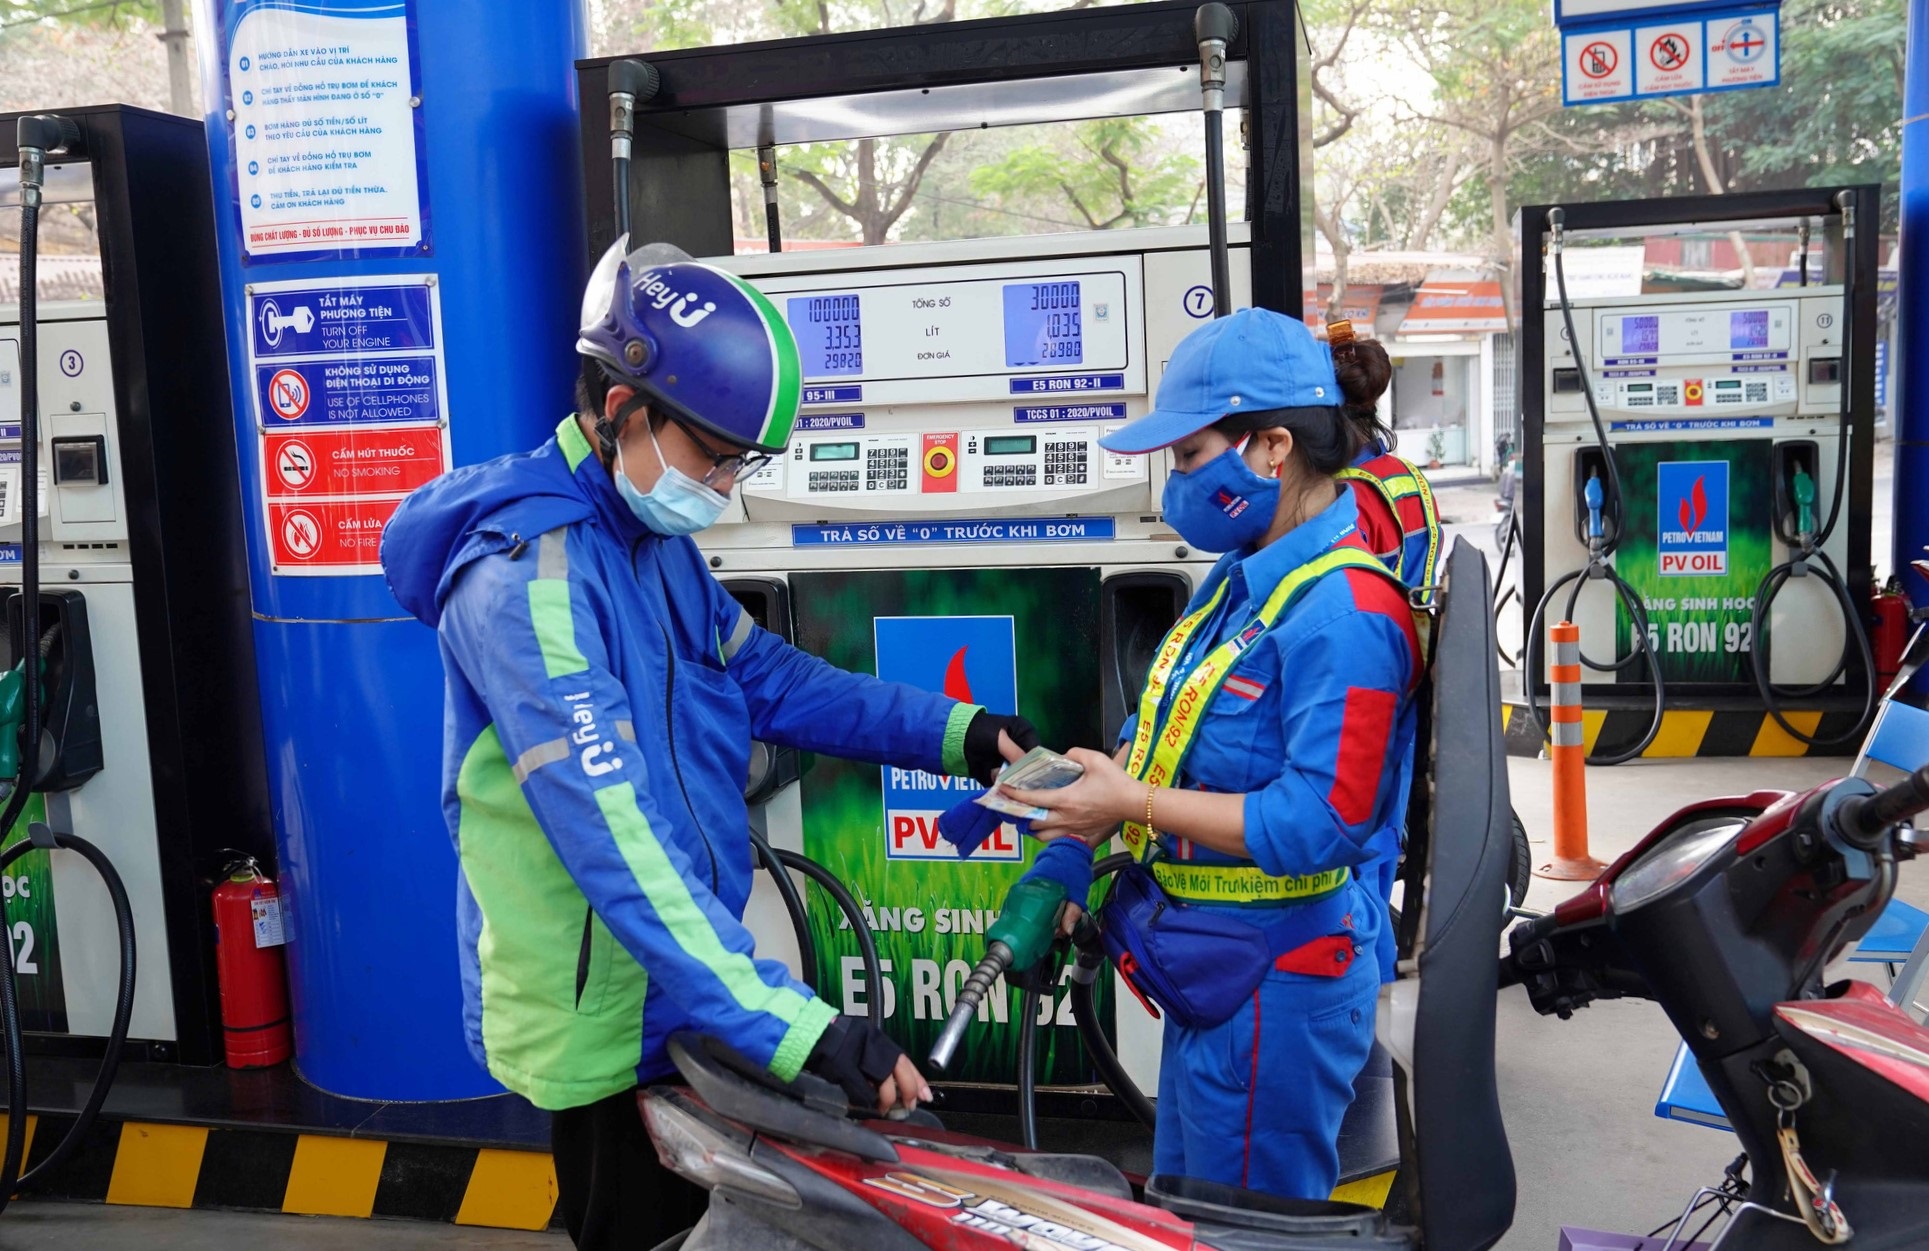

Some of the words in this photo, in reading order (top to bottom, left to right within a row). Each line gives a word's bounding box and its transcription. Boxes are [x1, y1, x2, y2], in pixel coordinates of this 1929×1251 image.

[350, 226, 367, 236] PHỤC
[380, 226, 393, 234] CHU
[320, 296, 337, 306] TẮT
[340, 295, 363, 305] MÁY
[912, 298, 935, 308] TỔNG
[939, 297, 951, 307] SỐ
[1031, 284, 1079, 310] 30000
[1195, 293, 1205, 309] 7
[321, 307, 366, 318] PHƯƠNG
[369, 306, 391, 318] TIỆN
[809, 297, 859, 322] 100000
[322, 326, 346, 336] TURN
[349, 326, 367, 334] OFF
[926, 325, 939, 336] LÍT
[323, 339, 350, 349] YOUR
[352, 337, 390, 347] ENGINE
[825, 352, 861, 369] 29820
[918, 352, 934, 360] ĐƠN
[936, 350, 950, 359] GIÁ
[68, 356, 75, 370] 3
[326, 366, 361, 376] KHÔNG
[364, 365, 377, 375] SỬ
[380, 364, 410, 375] DỤNG
[326, 378, 348, 388] ĐIỆN
[351, 376, 382, 387] THOẠI
[385, 376, 395, 385] DI
[398, 375, 429, 386] ĐỘNG
[1033, 380, 1046, 391] E5
[1049, 379, 1071, 390] RON
[1075, 378, 1100, 389] 92-II
[328, 397, 344, 406] USE
[347, 396, 360, 405] OF
[363, 394, 429, 405] CELLPHONES
[807, 390, 835, 400] 95-III
[329, 410, 337, 419] IS
[339, 409, 359, 419] NOT
[362, 407, 411, 418] ALLOWED
[1026, 410, 1047, 419] TCCS
[1050, 409, 1060, 418] 01
[1067, 407, 1113, 418] 2020/PVOIL
[810, 417, 853, 427] 2020/PVOIL
[1645, 422, 1655, 430] SỐ
[333, 447, 355, 459] CẤM
[358, 447, 378, 458] HÚT
[379, 446, 415, 457] THUỐC
[334, 468, 349, 477] NO
[352, 466, 400, 476] SMOKING
[339, 519, 361, 529] CẤM
[364, 518, 382, 529] LỬA
[821, 527, 852, 542] TRẢ
[858, 526, 880, 541] SỐ
[885, 524, 906, 540] VỀ
[944, 522, 1002, 538] TRƯỚC
[1009, 525, 1037, 537] KHI
[1046, 524, 1085, 537] BƠM
[1662, 531, 1723, 544] PETROVIETNAM
[340, 538, 357, 547] NO
[359, 537, 376, 546] FIRE
[1662, 555, 1689, 570] PV
[1692, 555, 1723, 570] OIL
[1634, 596, 1676, 611] ĂNG
[1681, 598, 1718, 610] SINH
[1723, 598, 1755, 613] HỌC
[1668, 622, 1716, 652] RON
[1724, 622, 1753, 652] 92
[1173, 685, 1198, 727] RON
[1140, 719, 1151, 744] E5
[1163, 726, 1182, 749] 92
[1125, 825, 1141, 846] 92
[1156, 868, 1173, 887] Bảo
[1173, 873, 1186, 894] Vệ
[1190, 874, 1210, 892] Môi
[1240, 875, 1279, 898] kiệm
[839, 900, 925, 932] XĂNG
